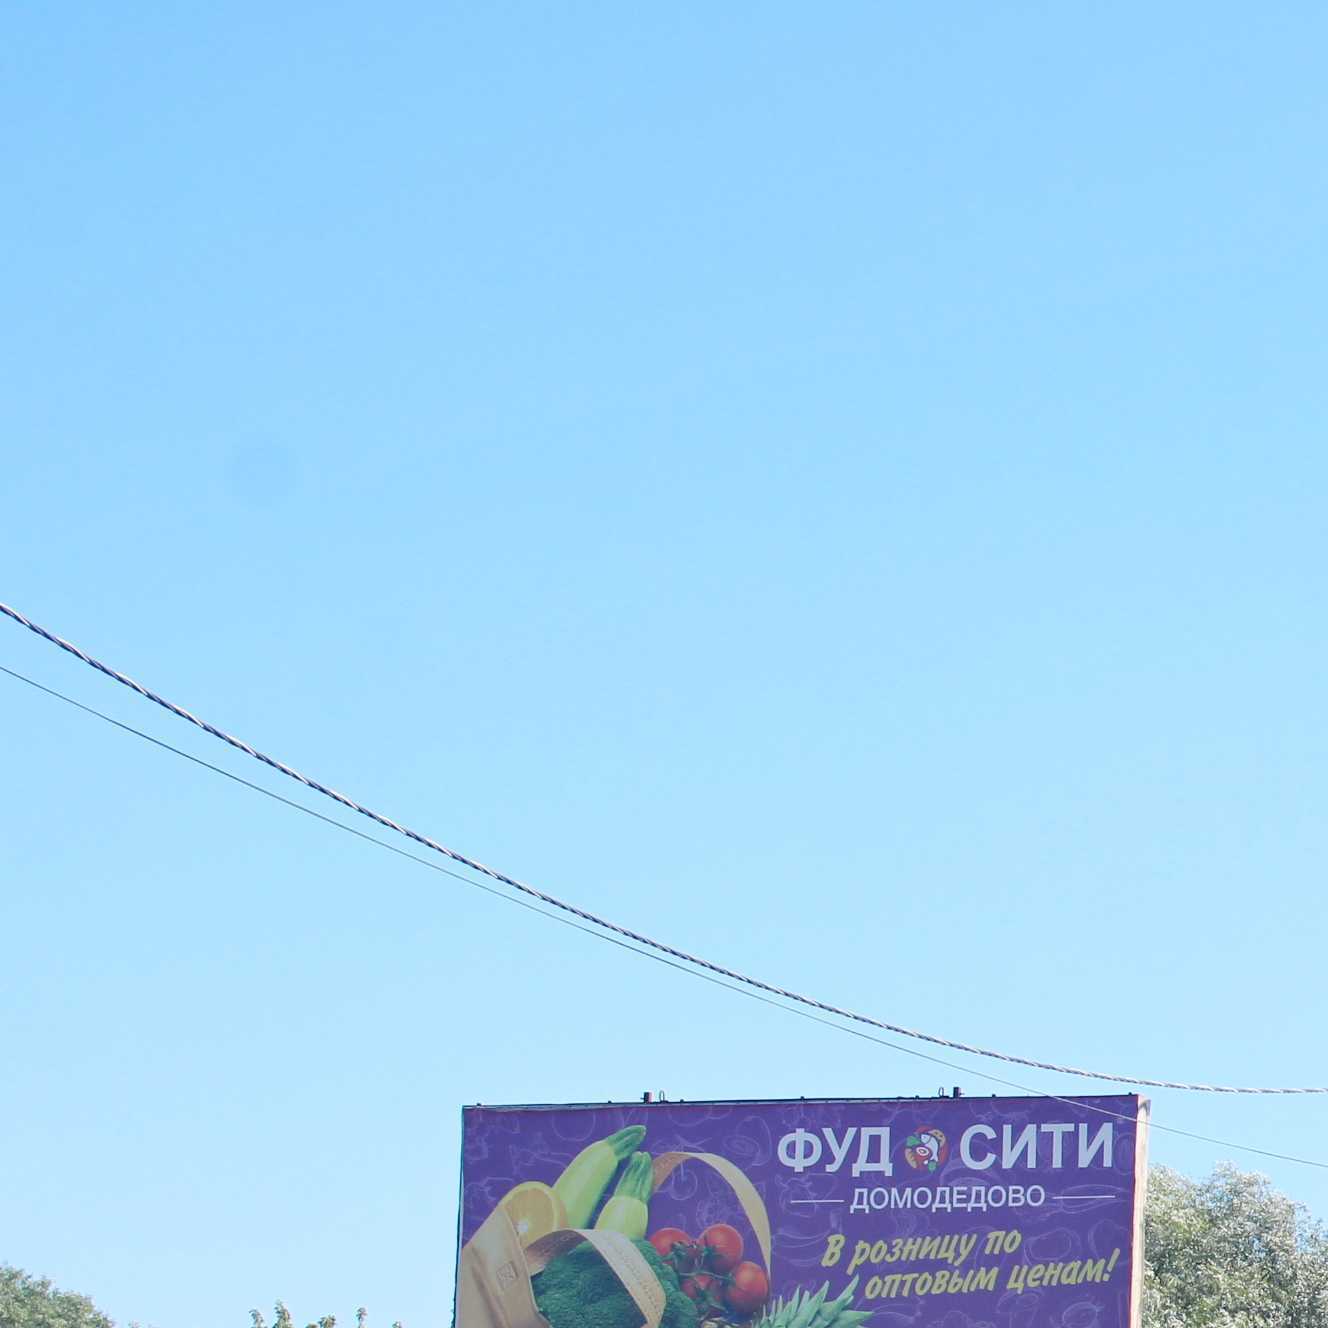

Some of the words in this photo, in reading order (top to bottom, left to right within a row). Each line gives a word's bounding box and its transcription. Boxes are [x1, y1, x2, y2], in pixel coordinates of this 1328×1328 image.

[777, 1127, 893, 1177] ФУД
[959, 1122, 1114, 1171] СИТИ
[850, 1185, 1046, 1213] ДОМОДЕДОВО
[821, 1233, 846, 1267] В
[846, 1234, 977, 1275] розницу
[985, 1229, 1022, 1255] по
[864, 1267, 999, 1299] оптовым
[1006, 1248, 1121, 1294] ценам!
